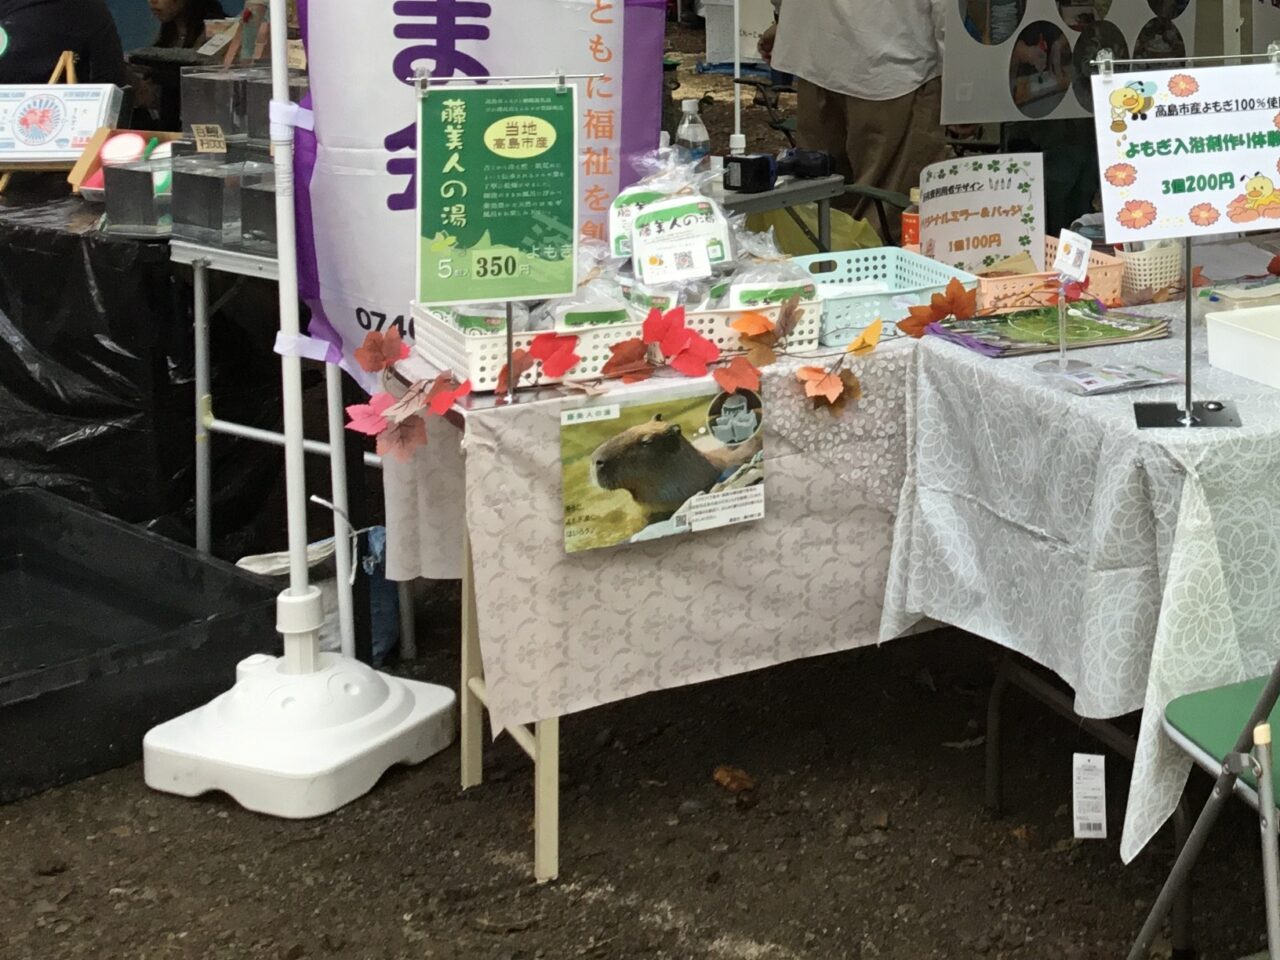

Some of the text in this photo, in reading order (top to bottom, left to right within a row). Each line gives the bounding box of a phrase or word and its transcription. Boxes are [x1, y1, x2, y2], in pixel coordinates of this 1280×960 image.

[506, 120, 538, 137] 当地
[493, 136, 549, 150] 高島市産
[440, 98, 468, 228] 藤美人の湯
[1162, 171, 1235, 195] 3個200円
[949, 233, 1002, 253] 1個100円
